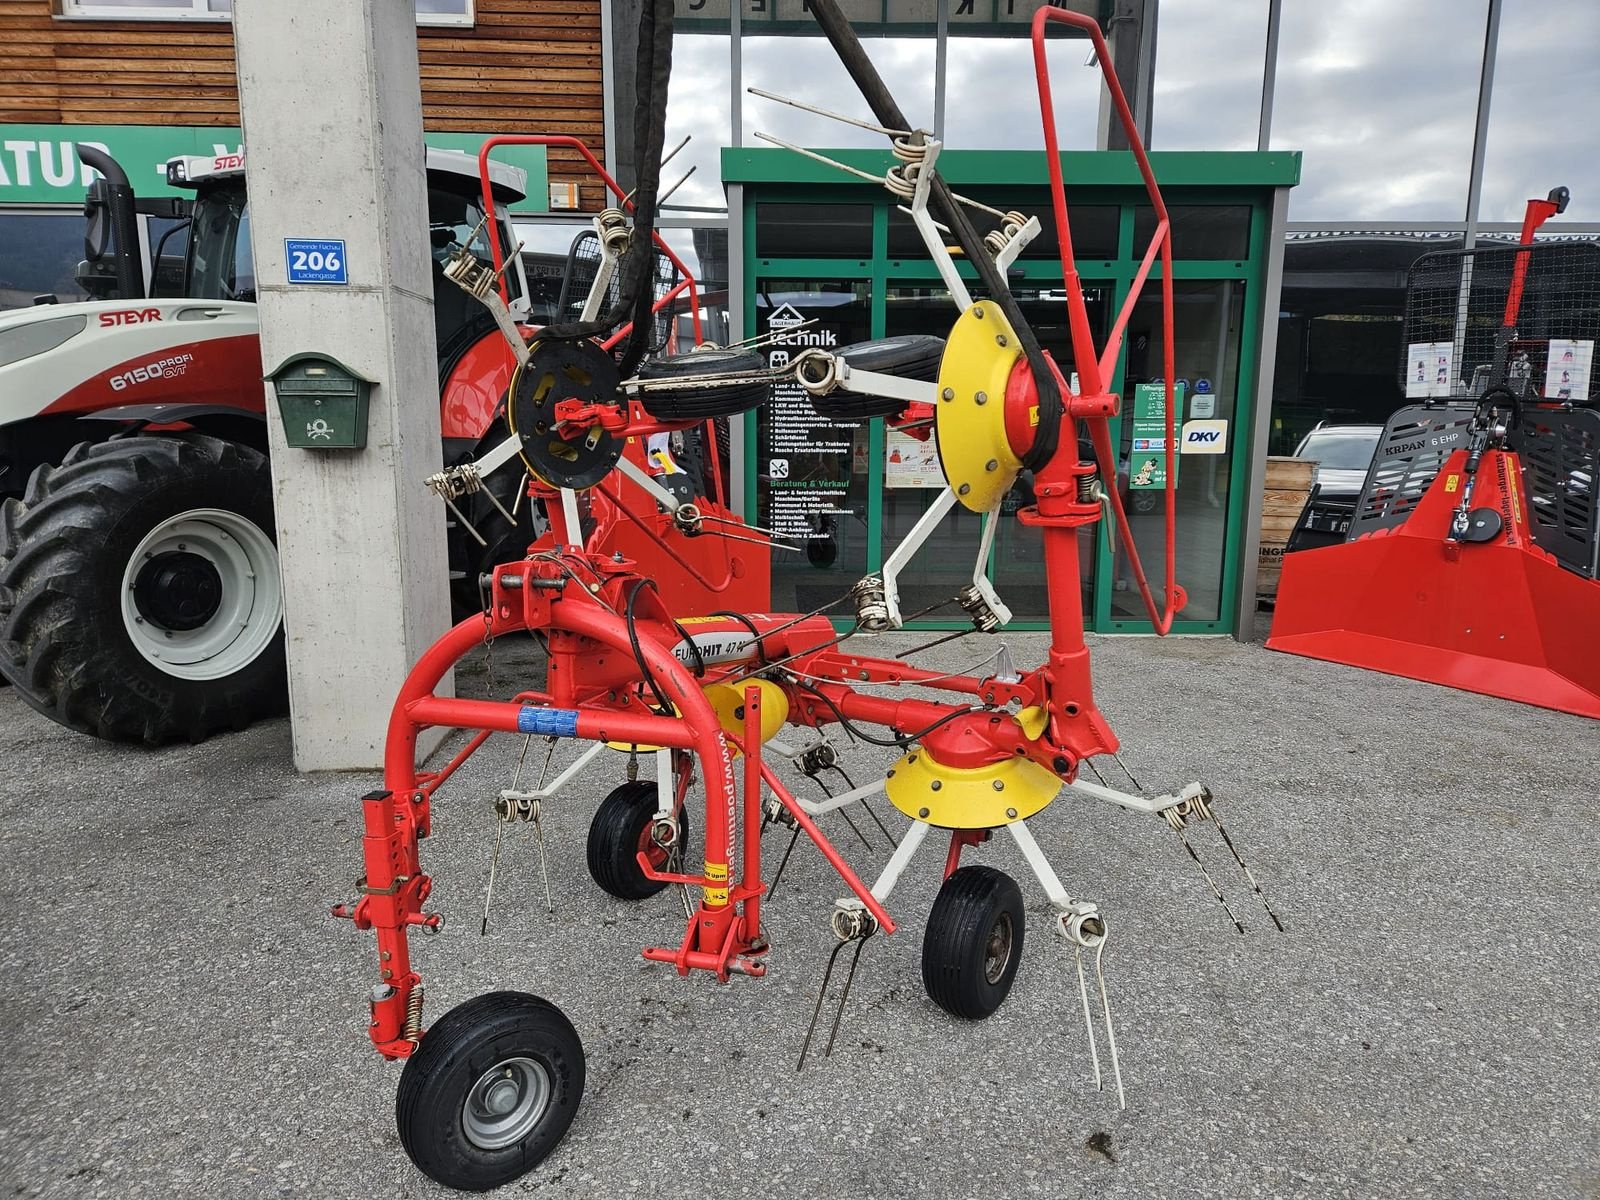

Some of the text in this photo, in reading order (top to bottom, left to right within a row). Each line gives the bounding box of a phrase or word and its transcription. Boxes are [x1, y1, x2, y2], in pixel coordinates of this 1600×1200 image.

[0, 141, 112, 187] TUR
[214, 156, 245, 170] STEY
[292, 252, 340, 270] 206
[98, 308, 162, 327] STEYR
[770, 330, 836, 346] technik
[110, 354, 194, 390] 6150 PROFI
[162, 364, 186, 378] CVT
[1188, 432, 1220, 442] DKV
[1385, 440, 1425, 455] KRPAN
[1440, 433, 1458, 444] EHP
[1496, 453, 1516, 545] salzburger-lagerhaus.at
[726, 642, 736, 654] 47
[718, 732, 737, 893] www.poettinger.at
